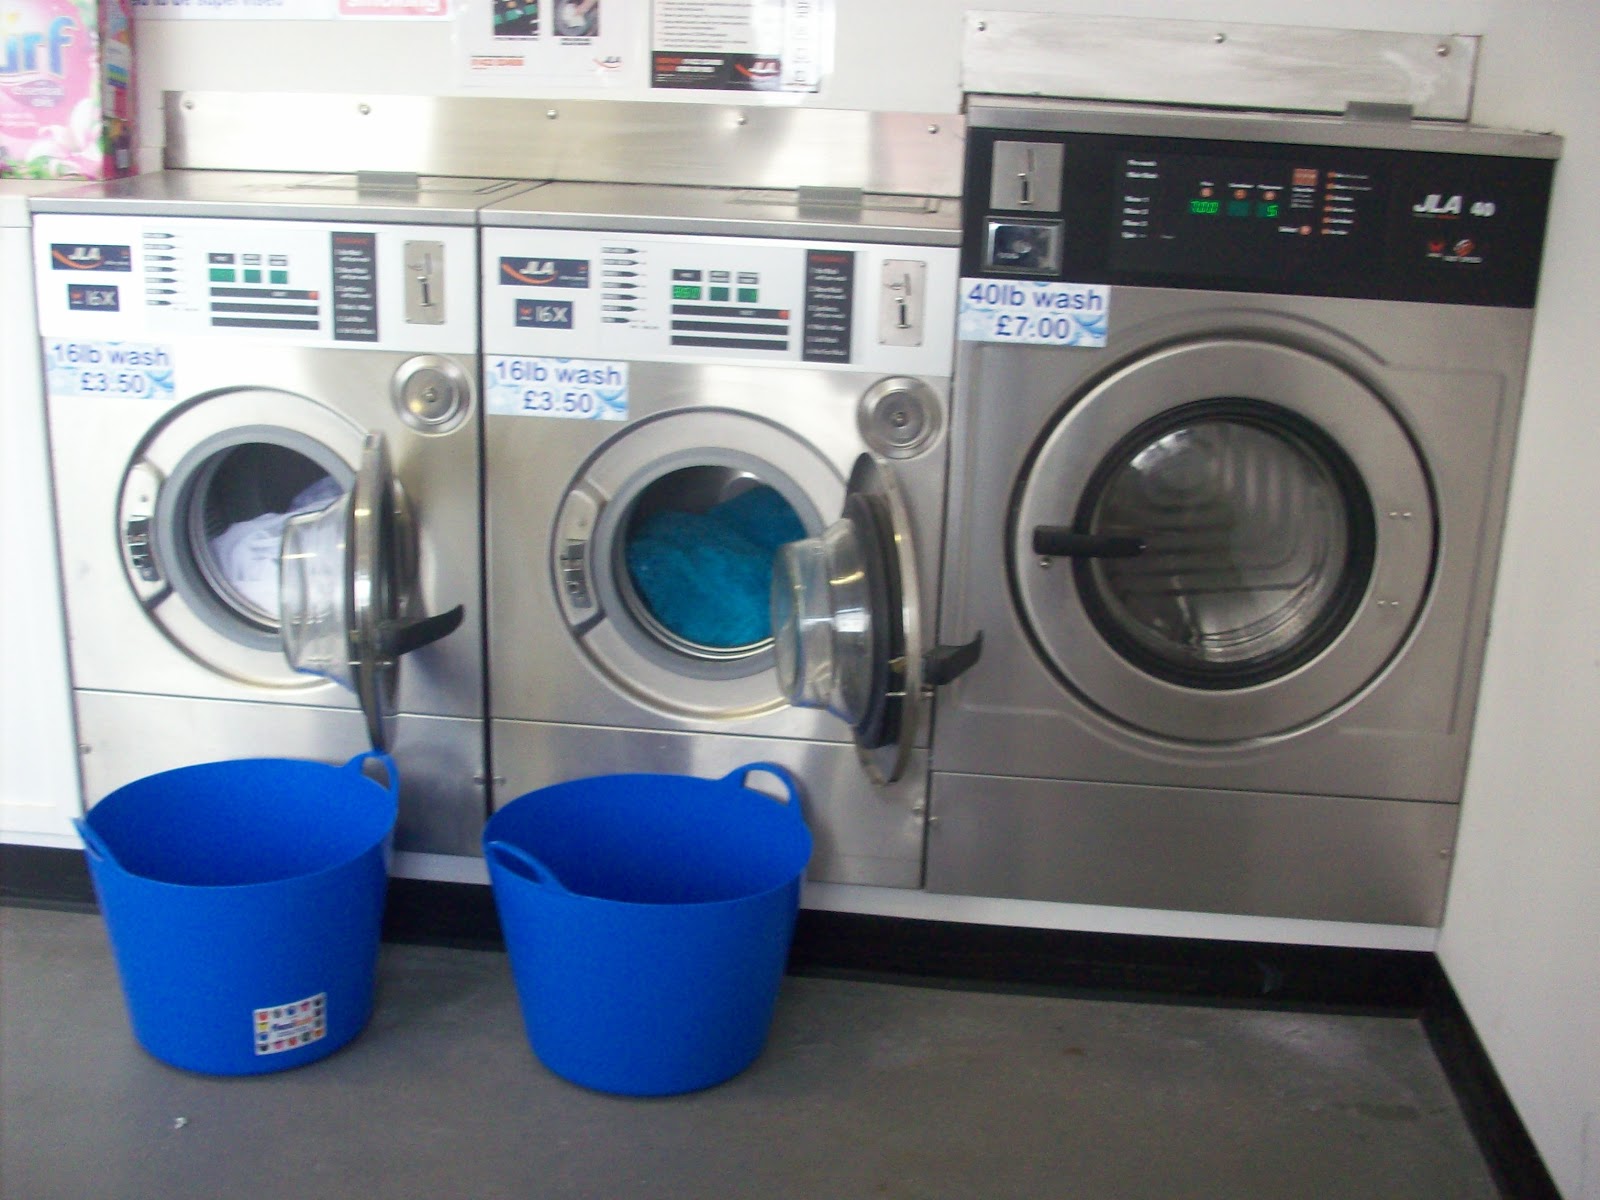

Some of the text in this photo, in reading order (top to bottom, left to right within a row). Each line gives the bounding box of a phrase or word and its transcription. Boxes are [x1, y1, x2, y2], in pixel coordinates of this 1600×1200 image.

[0, 15, 75, 77] urf
[1412, 194, 1496, 217] JLA 40
[67, 247, 101, 261] JLA
[519, 260, 555, 275] JLA
[85, 290, 117, 306] 16X
[968, 283, 1103, 311] 40lb wash
[535, 305, 569, 323] 16X
[996, 315, 1070, 339] £7.00
[54, 343, 169, 367] 16lb wash
[81, 372, 146, 394] £3.50
[495, 361, 622, 386] 16lb wash
[523, 390, 594, 413] £3.50
